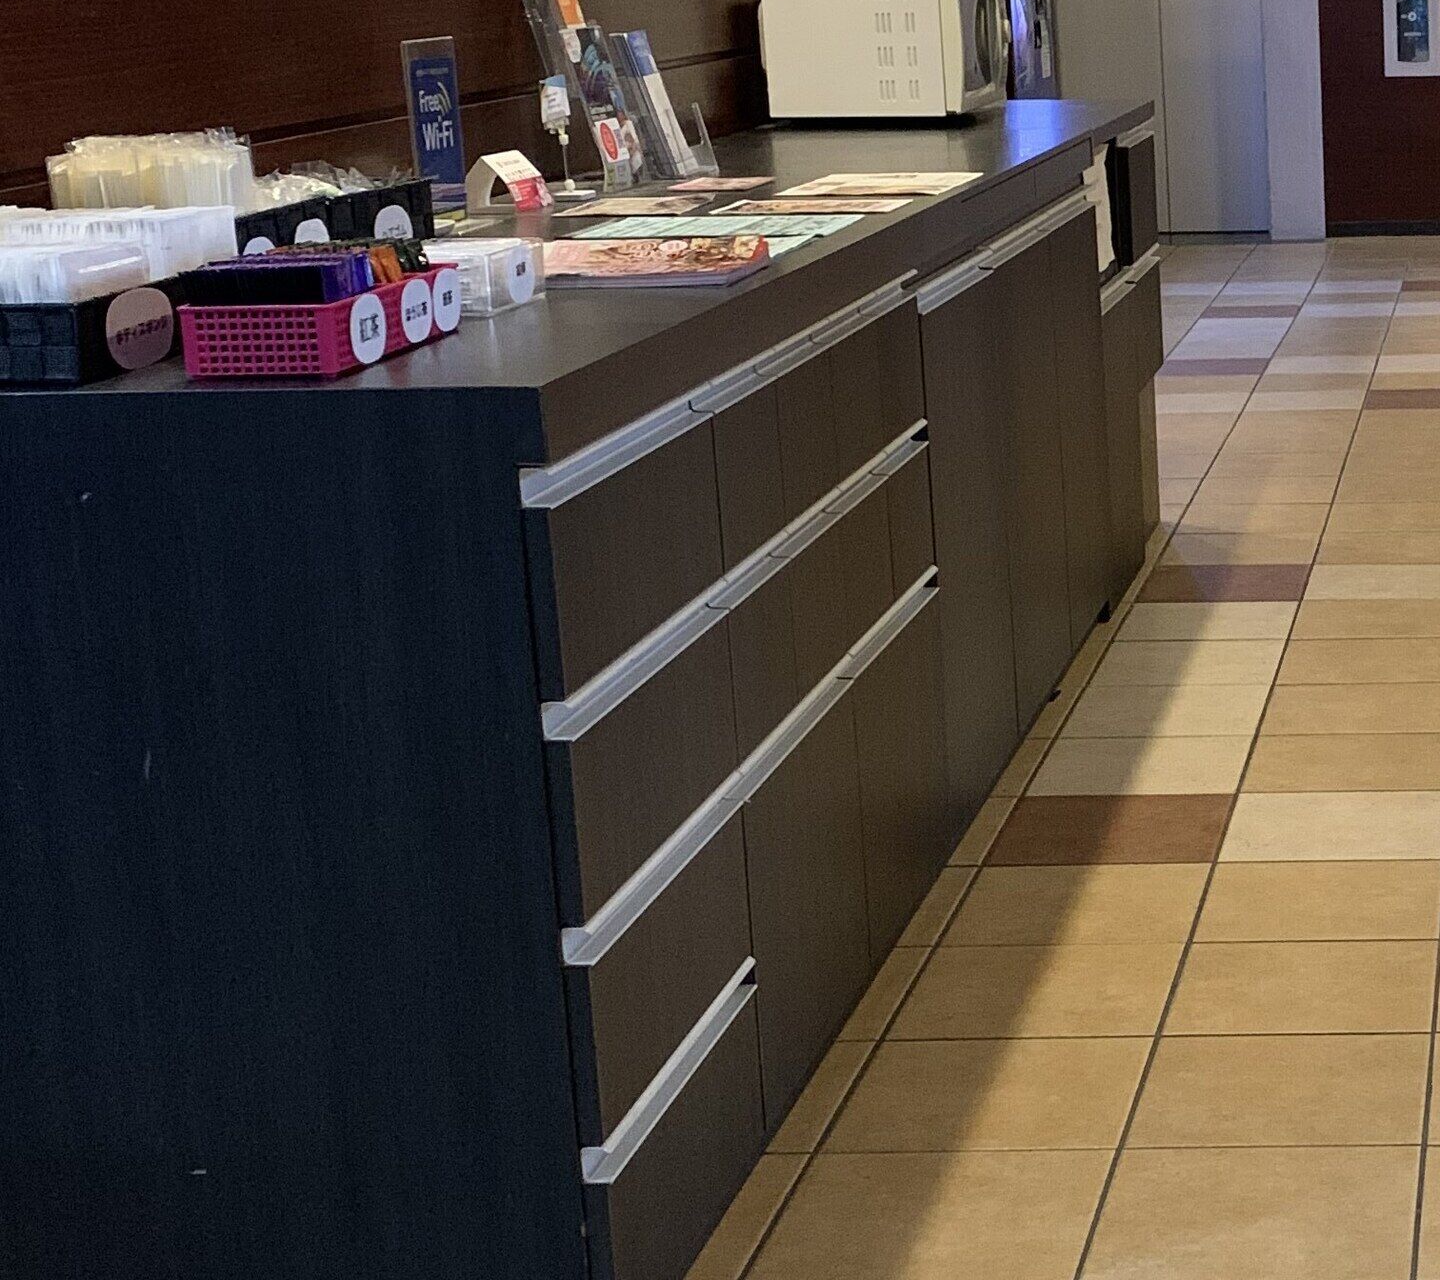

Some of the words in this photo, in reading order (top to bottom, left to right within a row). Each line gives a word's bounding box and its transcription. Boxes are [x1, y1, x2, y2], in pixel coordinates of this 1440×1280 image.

[419, 89, 442, 114] Free
[422, 117, 454, 151] Wi-Fi
[359, 313, 381, 344] 紅茶
